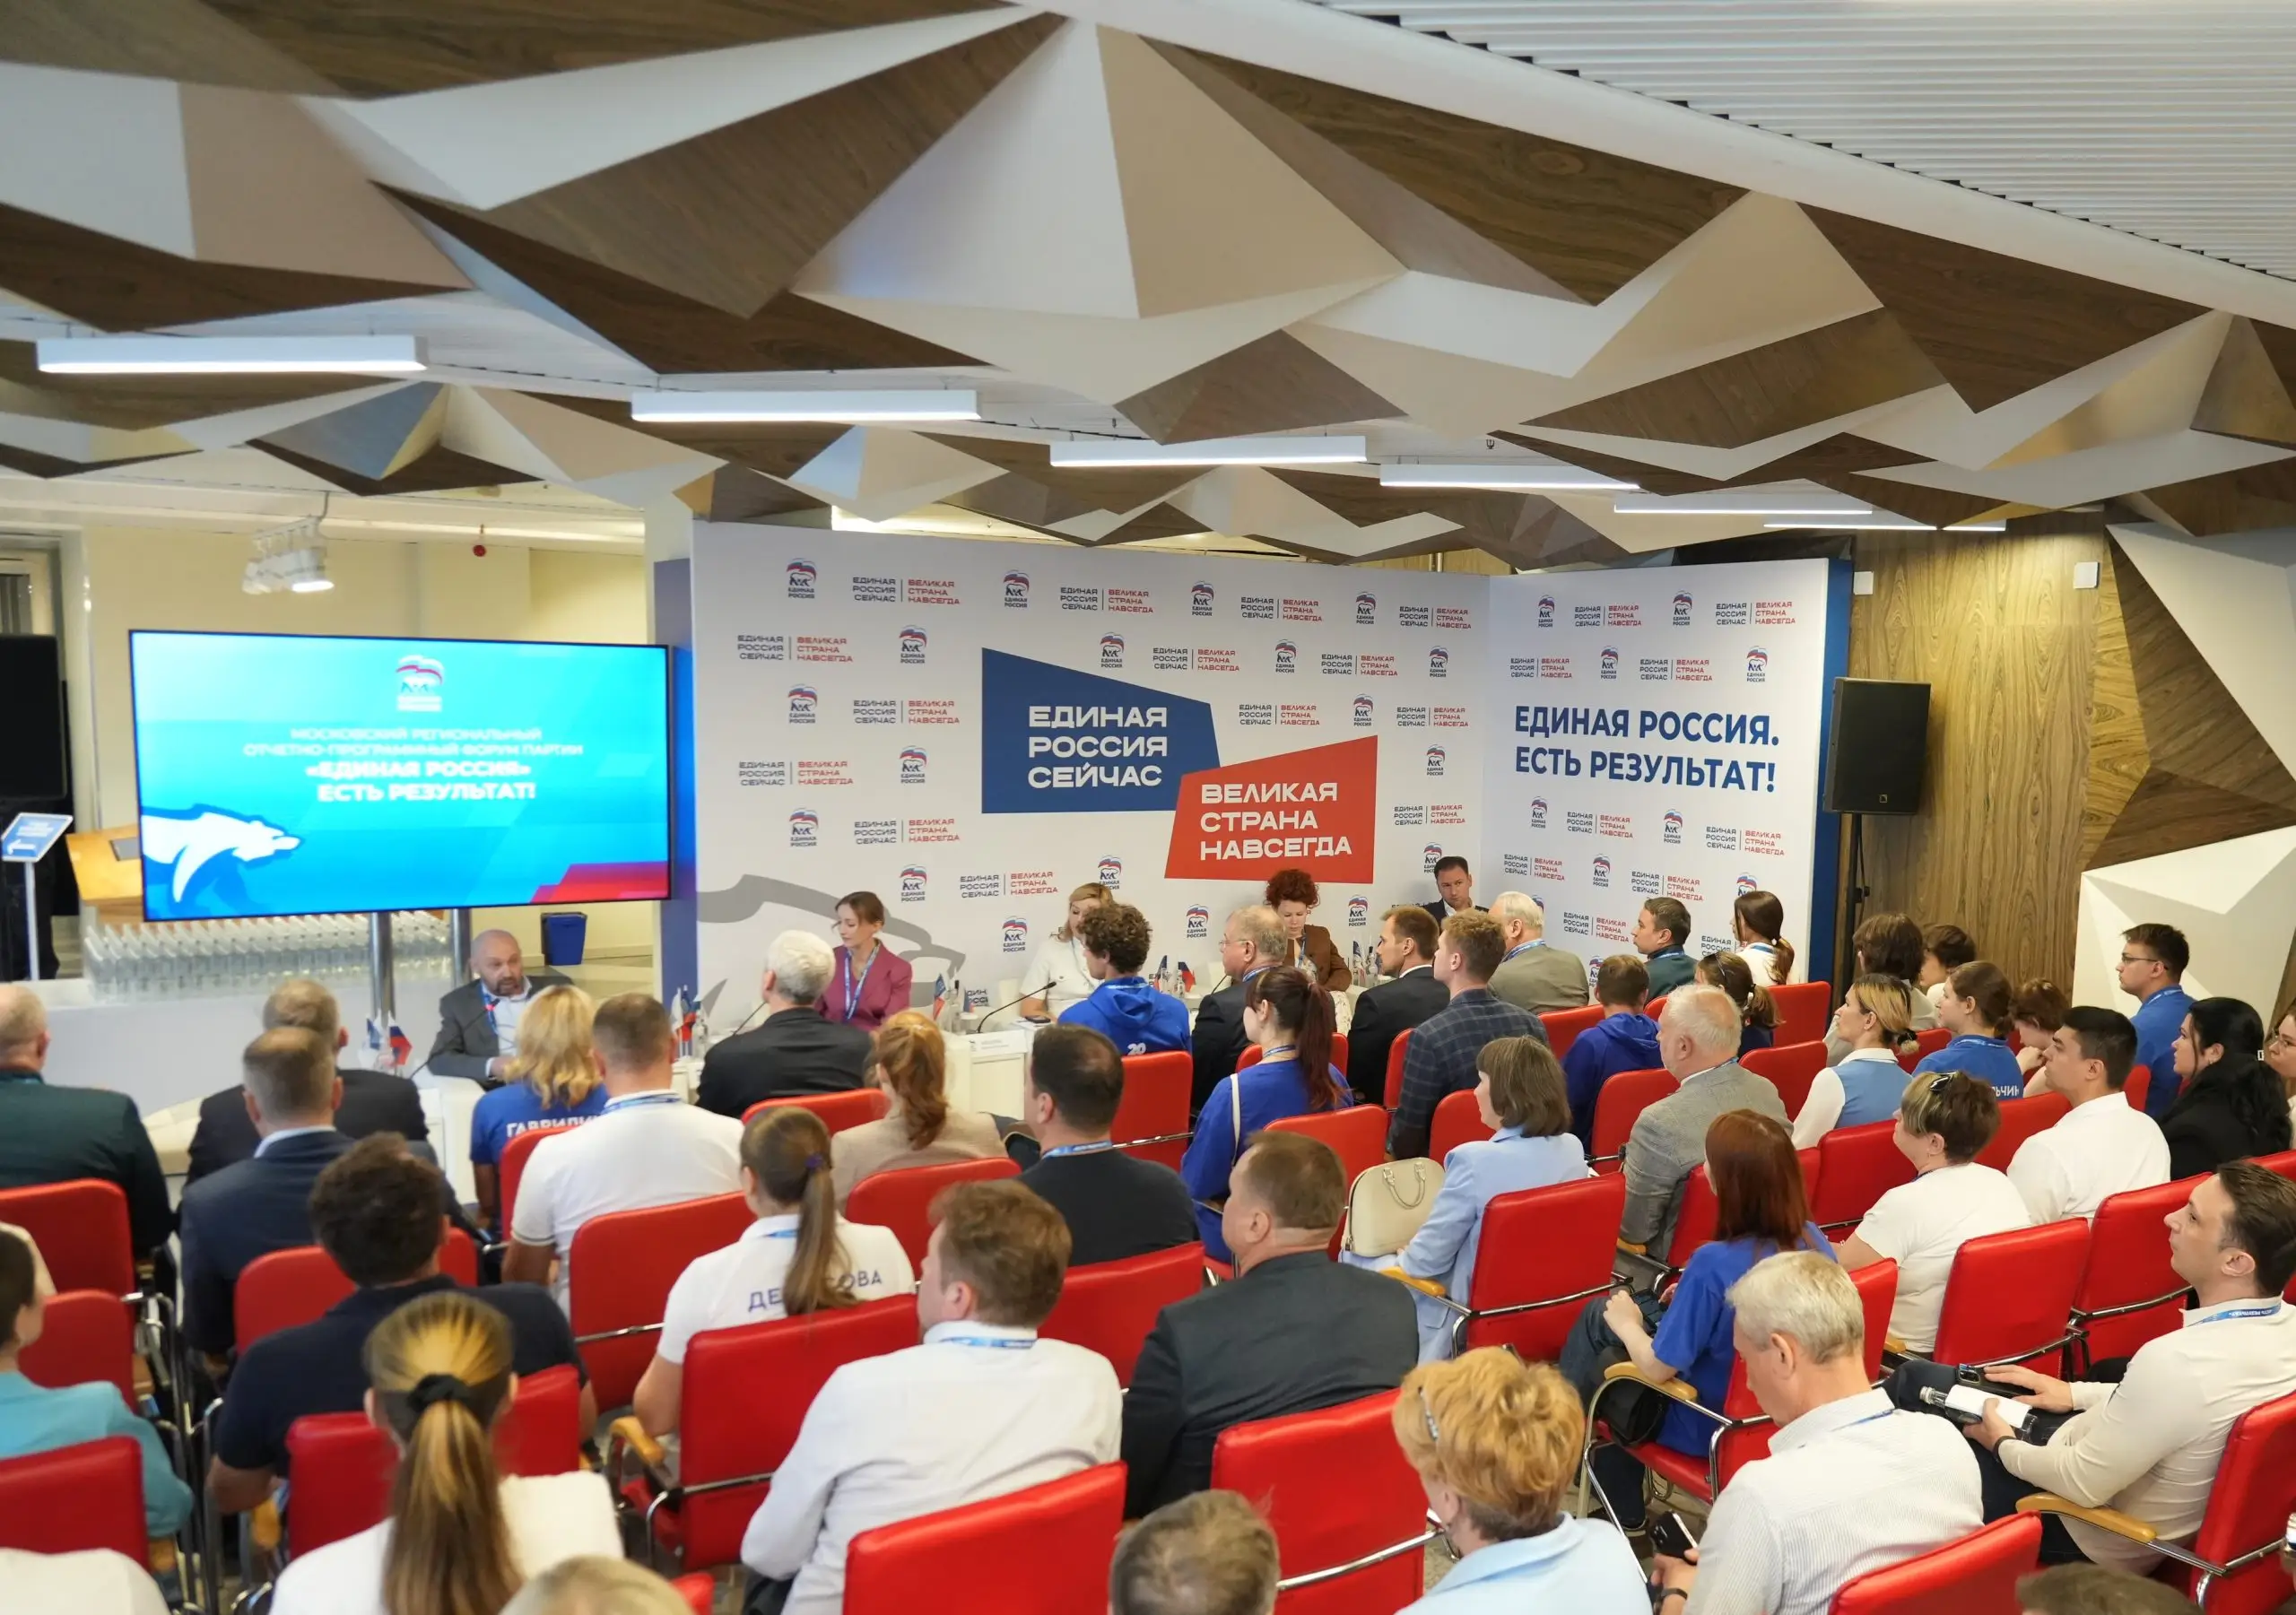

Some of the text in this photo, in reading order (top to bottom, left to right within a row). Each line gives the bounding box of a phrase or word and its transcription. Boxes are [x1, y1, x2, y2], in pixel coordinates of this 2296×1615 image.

[852, 577, 896, 586] ЕДИНАЯ
[908, 578, 955, 588] ВЕЛИКАЯ
[852, 585, 896, 594] РОССИЯ
[908, 587, 948, 596] СТРАНА
[1060, 586, 1098, 595] ЕДИНАЯ
[1108, 588, 1149, 597] ВЕЛИКАЯ
[854, 594, 896, 603] СЕЙЧАС
[908, 596, 961, 605] НАВСЕГДА
[1060, 595, 1098, 603] РОССИЯ
[1108, 596, 1143, 604] СТРАНА
[1240, 596, 1274, 604] ЕДИНАЯ
[1283, 599, 1319, 607] ВЕЛИКАЯ
[1061, 603, 1098, 612] СЕЙЧАС
[1108, 605, 1153, 613] НАВСЕГДА
[1240, 603, 1274, 612] РОССИЯ
[1755, 601, 1793, 609] ВЕЛИКАЯ
[1283, 606, 1314, 614] СТРАНА
[1241, 612, 1274, 620] СЕЙЧАС
[1283, 614, 1323, 622] НАВСЕГДА
[1400, 620, 1429, 628] СЕЙЧАС
[1436, 621, 1472, 630] НАВСЕГДА
[1575, 620, 1601, 628] СЕЙЧАС
[1716, 618, 1746, 626] СЕЙЧАС
[1754, 617, 1796, 625] НАВСЕГДА
[737, 635, 784, 643] ЕДИНАЯ
[796, 637, 847, 645] ВЕЛИКАЯ
[737, 643, 784, 652] РОССИЯ
[797, 645, 840, 653] СТРАНА
[1197, 648, 1236, 656] ВЕЛИКАЯ
[739, 652, 784, 661] СЕЙЧАС
[796, 655, 853, 663] НАВСЕГДА
[1152, 655, 1188, 663] РОССИЯ
[1361, 655, 1395, 663] ВЕЛИКАЯ
[1153, 663, 1187, 671] СЕЙЧАС
[1322, 667, 1352, 675] СЕЙЧАС
[853, 699, 896, 708] ЕДИНАЯ
[1029, 706, 1168, 729] ЕДИНАЯ
[1515, 706, 1779, 746] ЕДИНАЯ РОССИЯ.
[1029, 735, 1168, 758] РОССИЯ
[739, 761, 785, 769] ЕДИНАЯ
[797, 760, 848, 768] ВЕЛИКАЯ
[306, 761, 531, 779] «ЕДИНАЯ РОССИЯ»
[738, 769, 786, 777] РОССИЯ
[1516, 746, 1776, 793] ЕСТЬ РЕЗУЛЬТАТ!
[1028, 761, 1162, 788] СЕЙЧАС
[740, 778, 785, 786] СЕЙЧАС
[798, 777, 854, 786] НАВСЕГДА
[317, 782, 536, 802] ЕСТЬ РЕЗУЛЬТАТ!
[1201, 782, 1338, 804] ВЕЛИКАЯ
[1567, 811, 1594, 820] ЕДИНАЯ
[1599, 814, 1631, 823] ВЕЛИКАЯ
[854, 821, 897, 829] ЕДИНАЯ
[909, 818, 955, 827] ВЕЛИКАЯ
[1200, 810, 1318, 833] СТРАНА
[1566, 818, 1593, 827] РОССИЯ
[1599, 821, 1626, 829] СТРАНА
[854, 829, 897, 837] РОССИЯ
[909, 827, 948, 835] СТРАНА
[1567, 825, 1593, 834] СЕЙЧАС
[1599, 829, 1633, 838] НАВСЕГДА
[1706, 826, 1737, 835] ЕДИНАЯ
[1744, 829, 1781, 839] ВЕЛИКАЯ
[856, 837, 897, 845] СЕЙЧАС
[909, 834, 960, 842] НАВСЕГДА
[1705, 833, 1736, 843] РОССИЯ
[1744, 838, 1776, 847] СТРАНА
[1200, 836, 1352, 861] НАВСЕГДА
[1706, 841, 1736, 851] СЕЙЧАС
[1744, 846, 1785, 855] НАВСЕГДА
[960, 874, 999, 883] ЕДИНАЯ
[1010, 871, 1054, 880] ВЕЛИКАЯ
[1631, 871, 1660, 880] ЕДИНАЯ
[1010, 880, 1048, 888] СТРАНА
[1631, 878, 1659, 887] РОССИЯ
[1667, 875, 1700, 886] ВЕЛИКАЯ
[960, 881, 999, 890] РОССИЯ
[1631, 885, 1659, 895] СЕЙЧАС
[1666, 882, 1695, 893] СТРАНА
[961, 890, 999, 899] СЕЙЧАС
[1010, 886, 1058, 895] НАВСЕГДА
[1666, 891, 1703, 901] НАВСЕГДА
